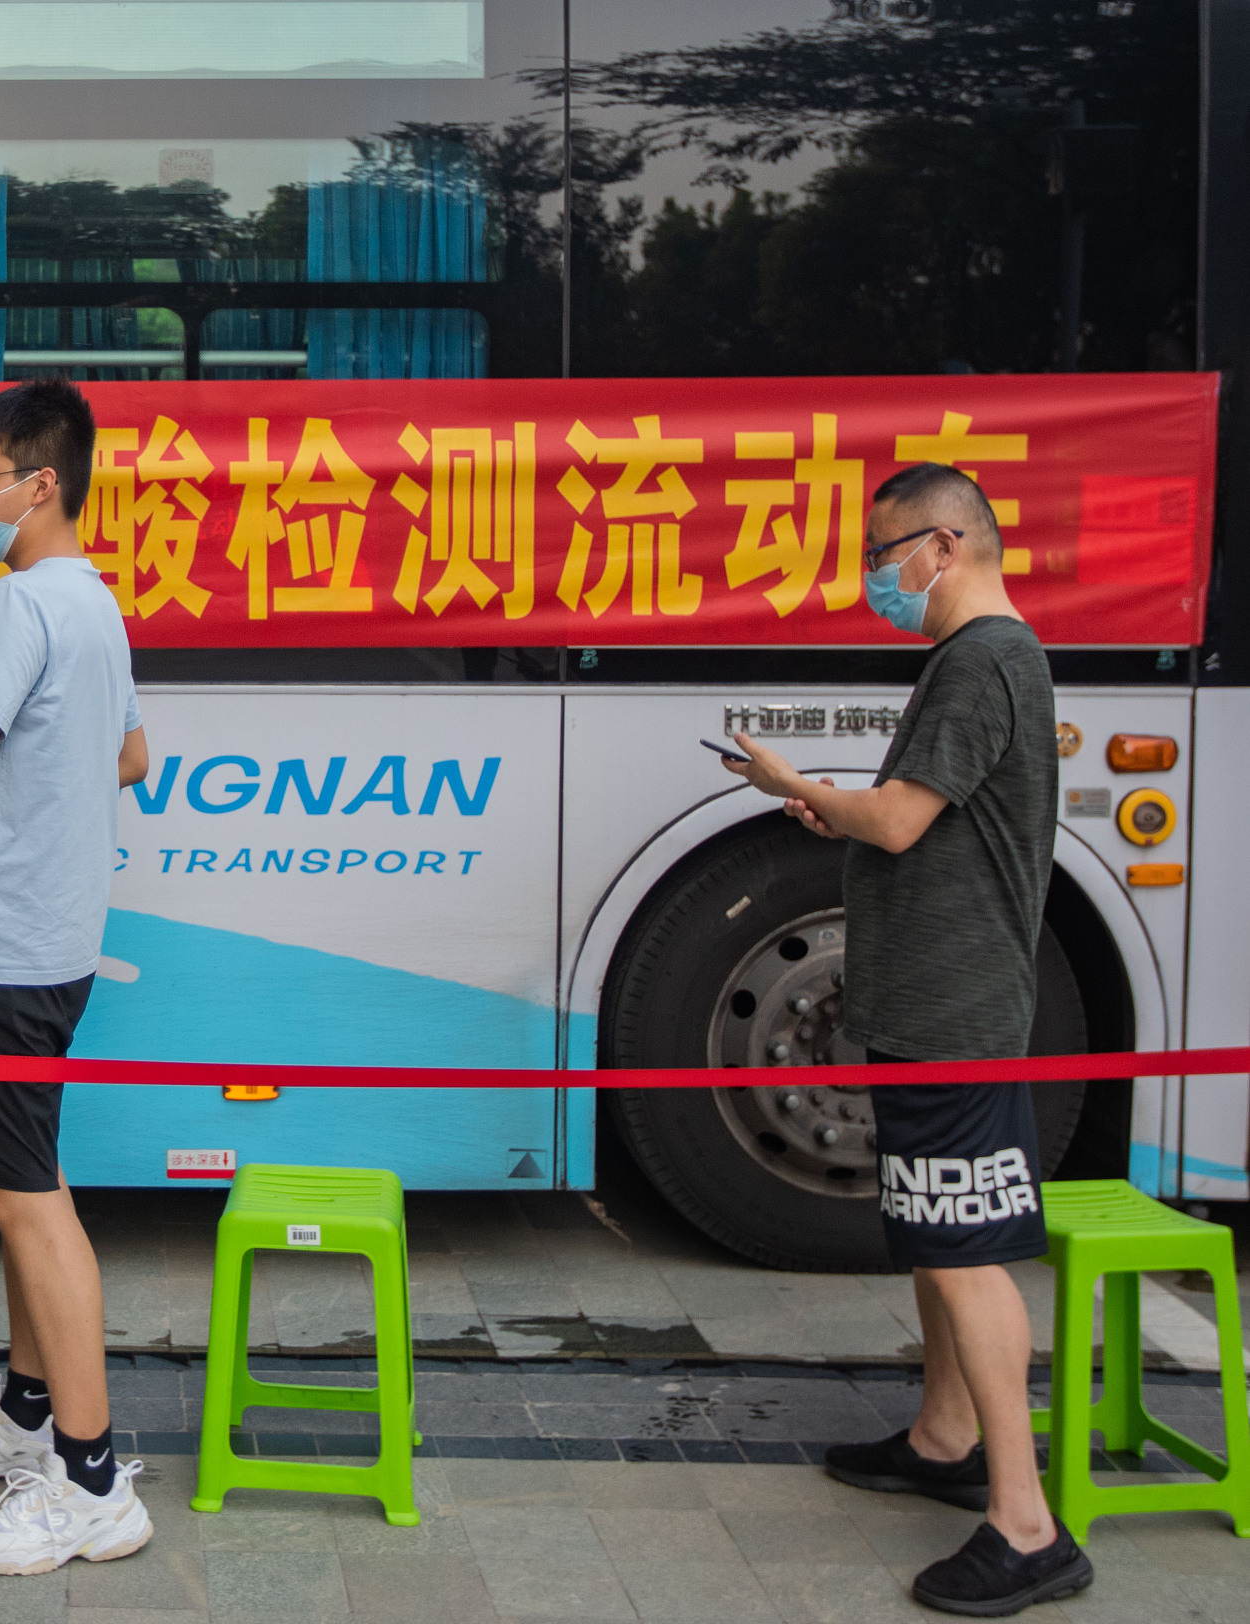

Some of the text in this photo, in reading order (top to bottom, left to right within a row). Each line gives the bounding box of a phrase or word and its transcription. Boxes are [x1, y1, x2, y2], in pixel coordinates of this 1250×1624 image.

[158, 848, 482, 875] TRANSPORT
[172, 1154, 221, 1166] 涉水深度
[880, 1183, 1039, 1225] ARMOUR
